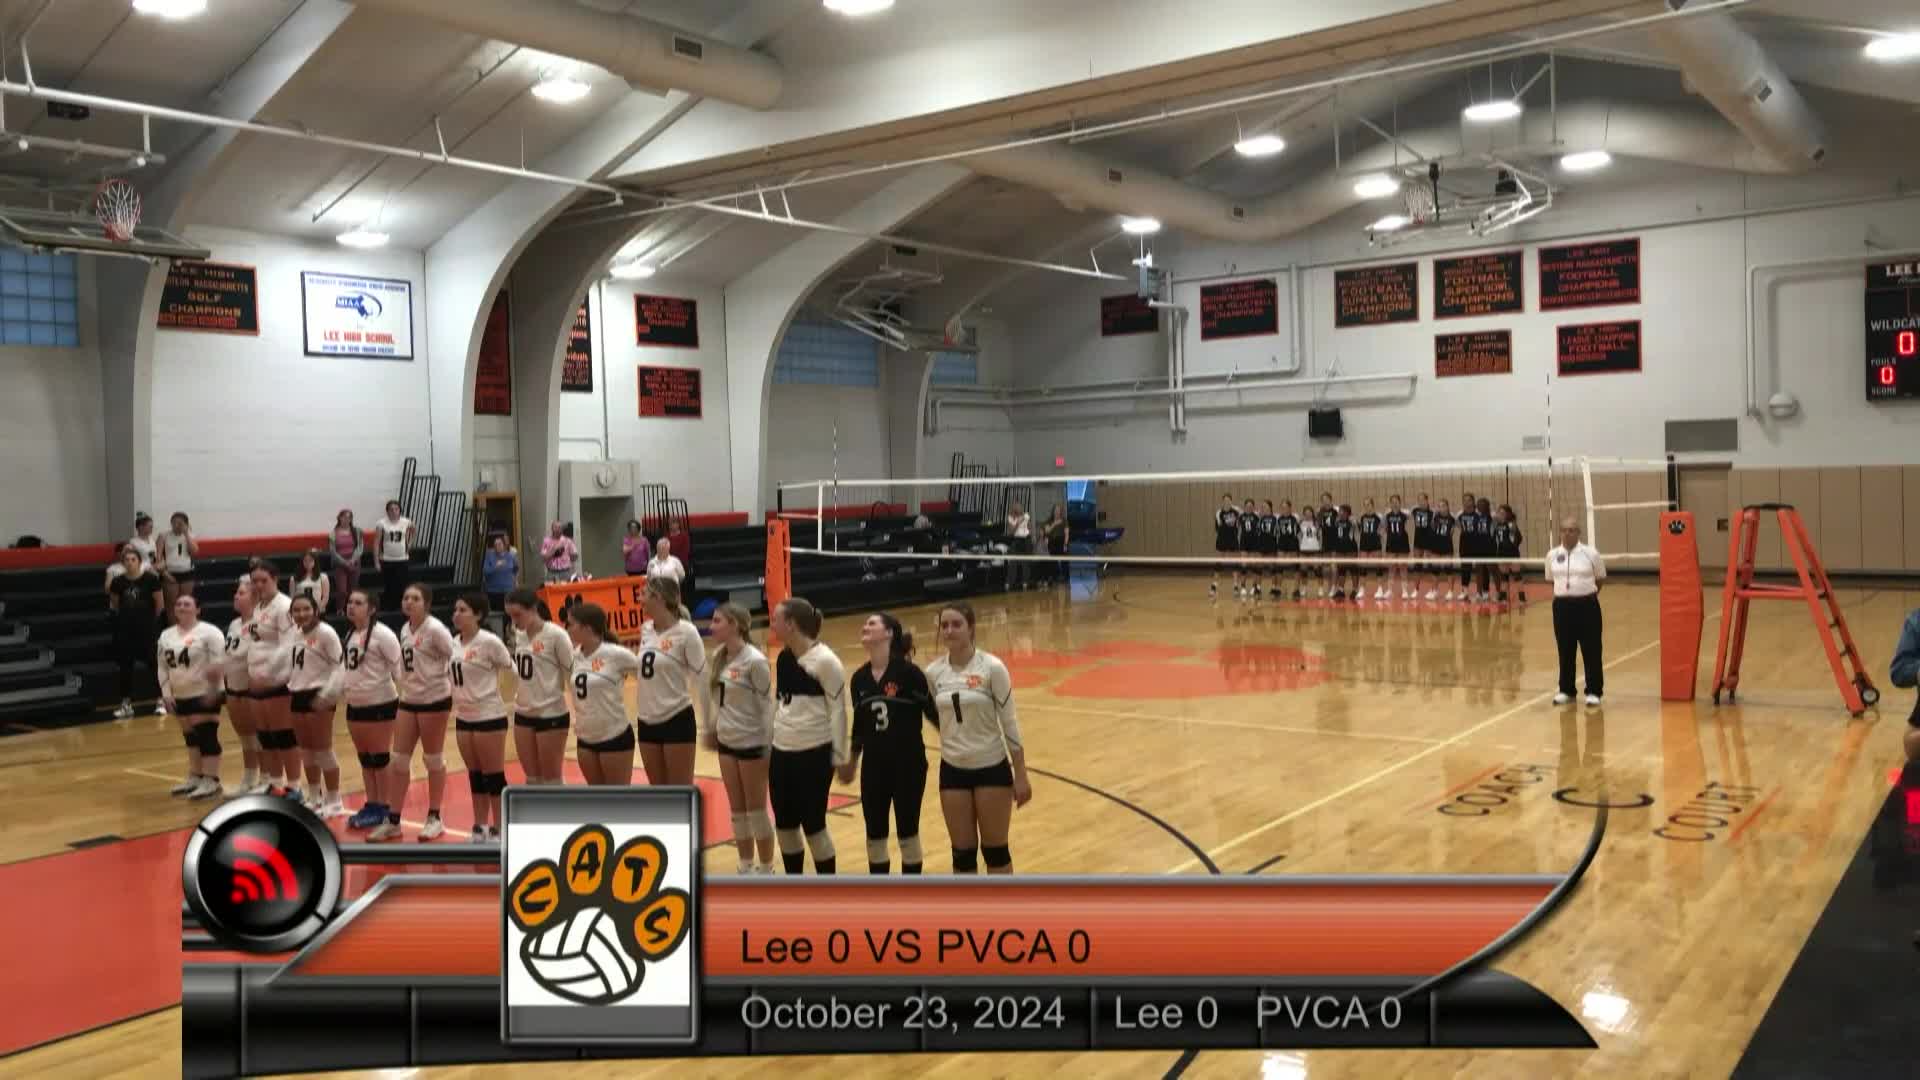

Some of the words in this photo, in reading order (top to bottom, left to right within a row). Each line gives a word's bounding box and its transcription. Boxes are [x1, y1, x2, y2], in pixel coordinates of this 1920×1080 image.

[1899, 331, 1914, 354] 0
[1881, 366, 1893, 384] 0
[618, 584, 641, 606] LE
[164, 647, 191, 669] 24
[292, 646, 305, 670] 14
[516, 653, 533, 680] 10
[641, 651, 656, 679] 8
[452, 661, 464, 687] 11
[575, 673, 587, 699] 9
[871, 701, 889, 732] 3
[951, 691, 963, 724] 1
[1437, 763, 1558, 816] COACH
[1653, 781, 1761, 842] COURT
